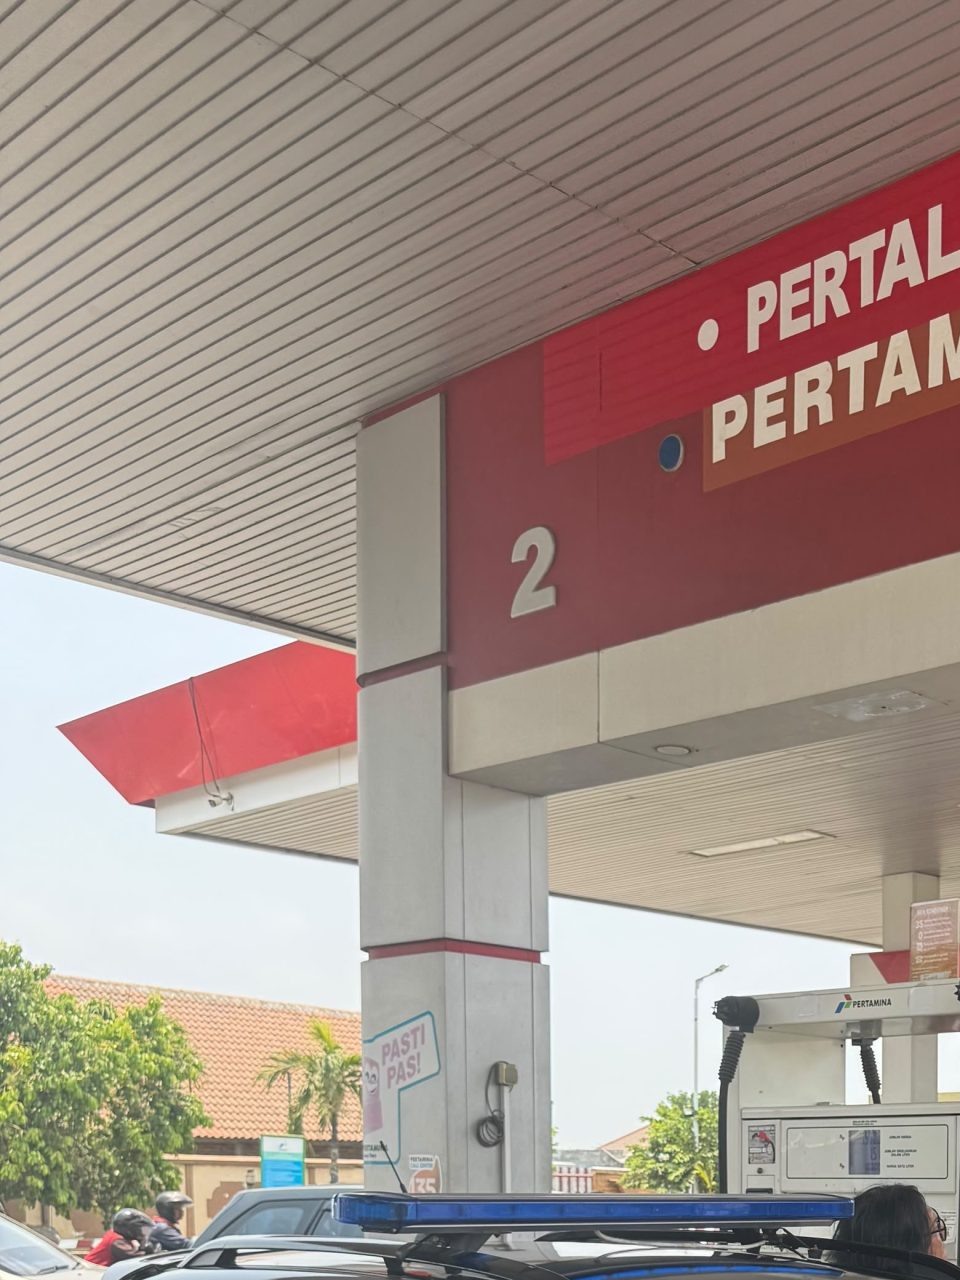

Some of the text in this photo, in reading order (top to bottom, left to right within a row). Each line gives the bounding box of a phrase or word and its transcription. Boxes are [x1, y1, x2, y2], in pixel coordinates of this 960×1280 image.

[510, 526, 557, 619] 2
[853, 998, 892, 1008] PERTAMINA
[381, 1023, 425, 1066] PASTI
[386, 1052, 421, 1089] PAS!
